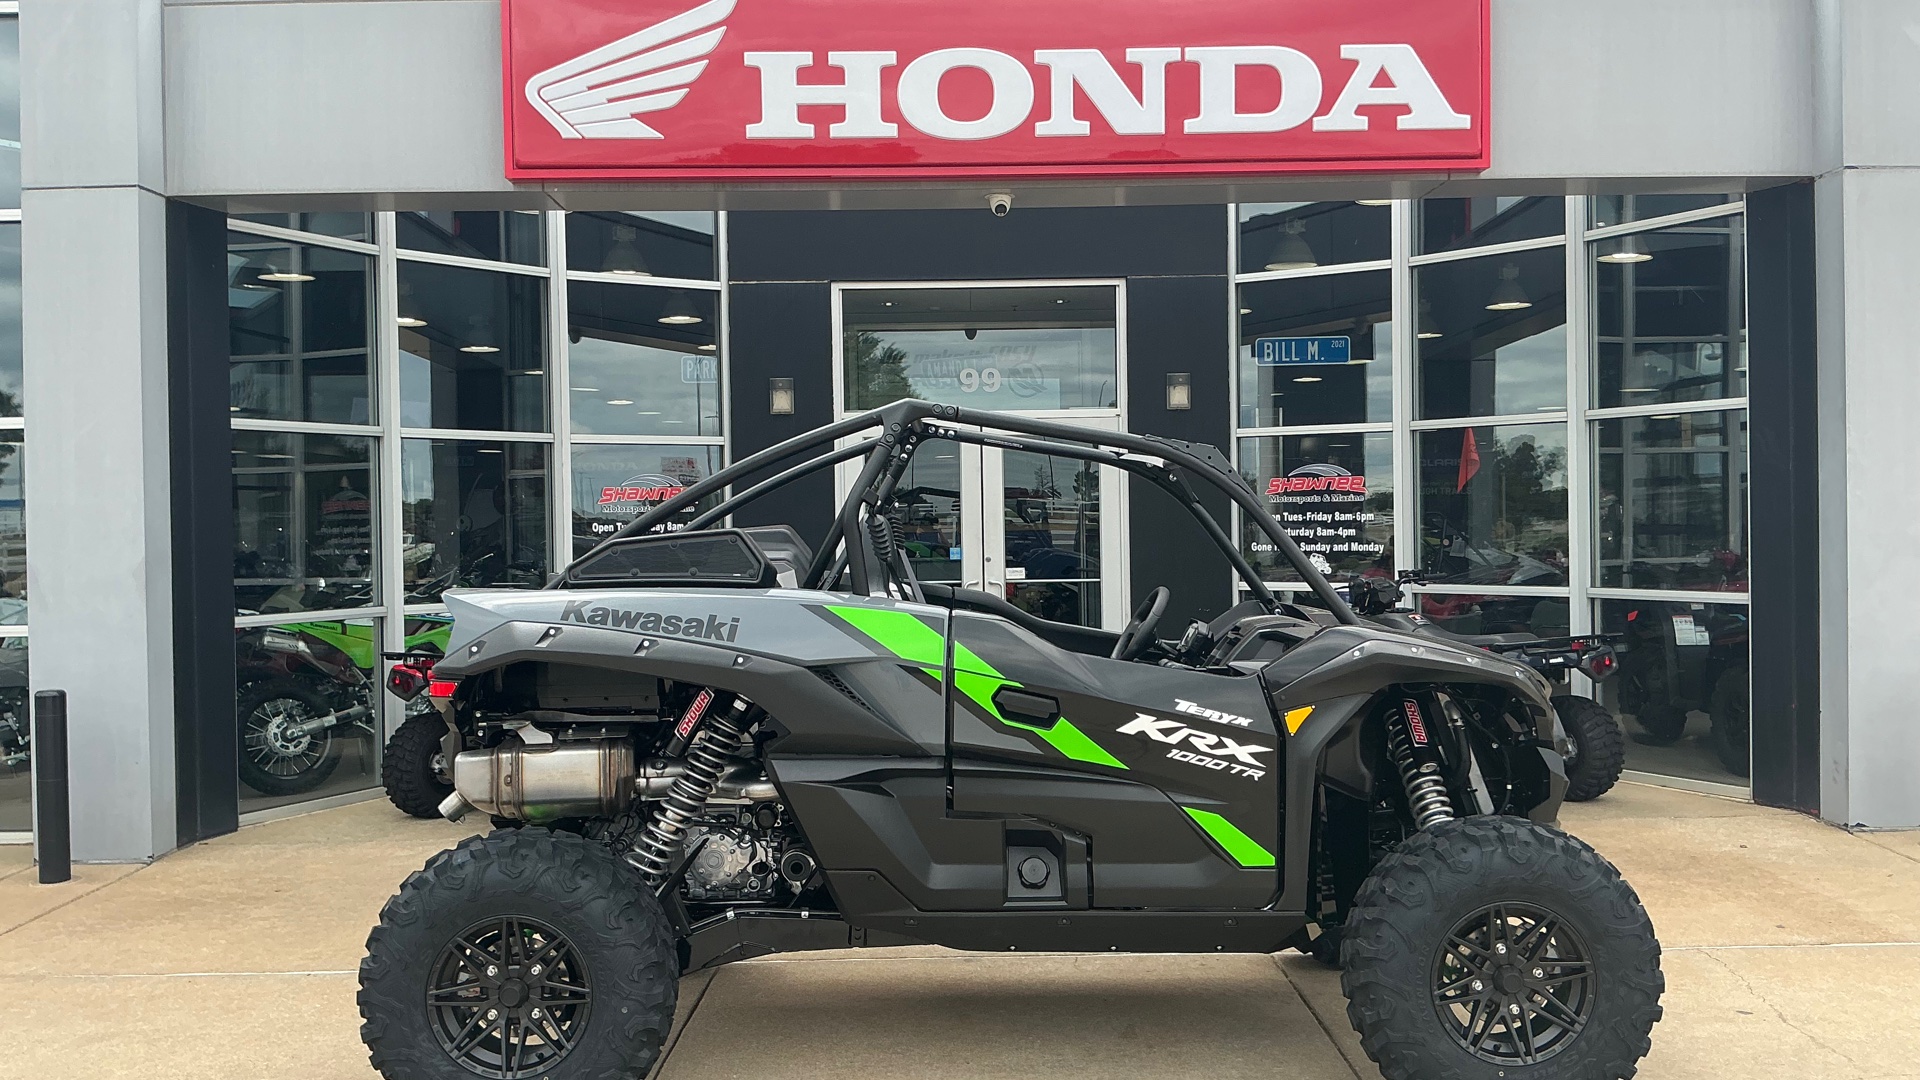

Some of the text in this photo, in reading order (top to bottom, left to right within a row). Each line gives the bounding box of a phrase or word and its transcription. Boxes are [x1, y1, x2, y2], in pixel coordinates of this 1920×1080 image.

[744, 44, 1471, 139] HONDA
[1263, 340, 1325, 361] BILL M.
[1331, 340, 1345, 348] 2021
[959, 368, 1001, 393] 99
[1265, 476, 1368, 494] SHAWNEE
[598, 486, 688, 504] SHAWNE
[1269, 495, 1321, 504] Motorsports
[1331, 494, 1364, 502] Marine
[1283, 511, 1332, 522] Tues-Friday
[1334, 512, 1375, 522] 8am-6pm
[592, 523, 614, 534] Open
[1316, 527, 1356, 538] 8am-4pm
[1251, 542, 1272, 551] Gone
[1300, 542, 1330, 553] Sunday
[1332, 542, 1349, 551] and
[1350, 542, 1385, 553] Monday
[560, 600, 741, 643] Kawasaki
[679, 690, 710, 738] SHOWA
[1404, 701, 1428, 743] SHOWA
[1115, 712, 1274, 768] KRX
